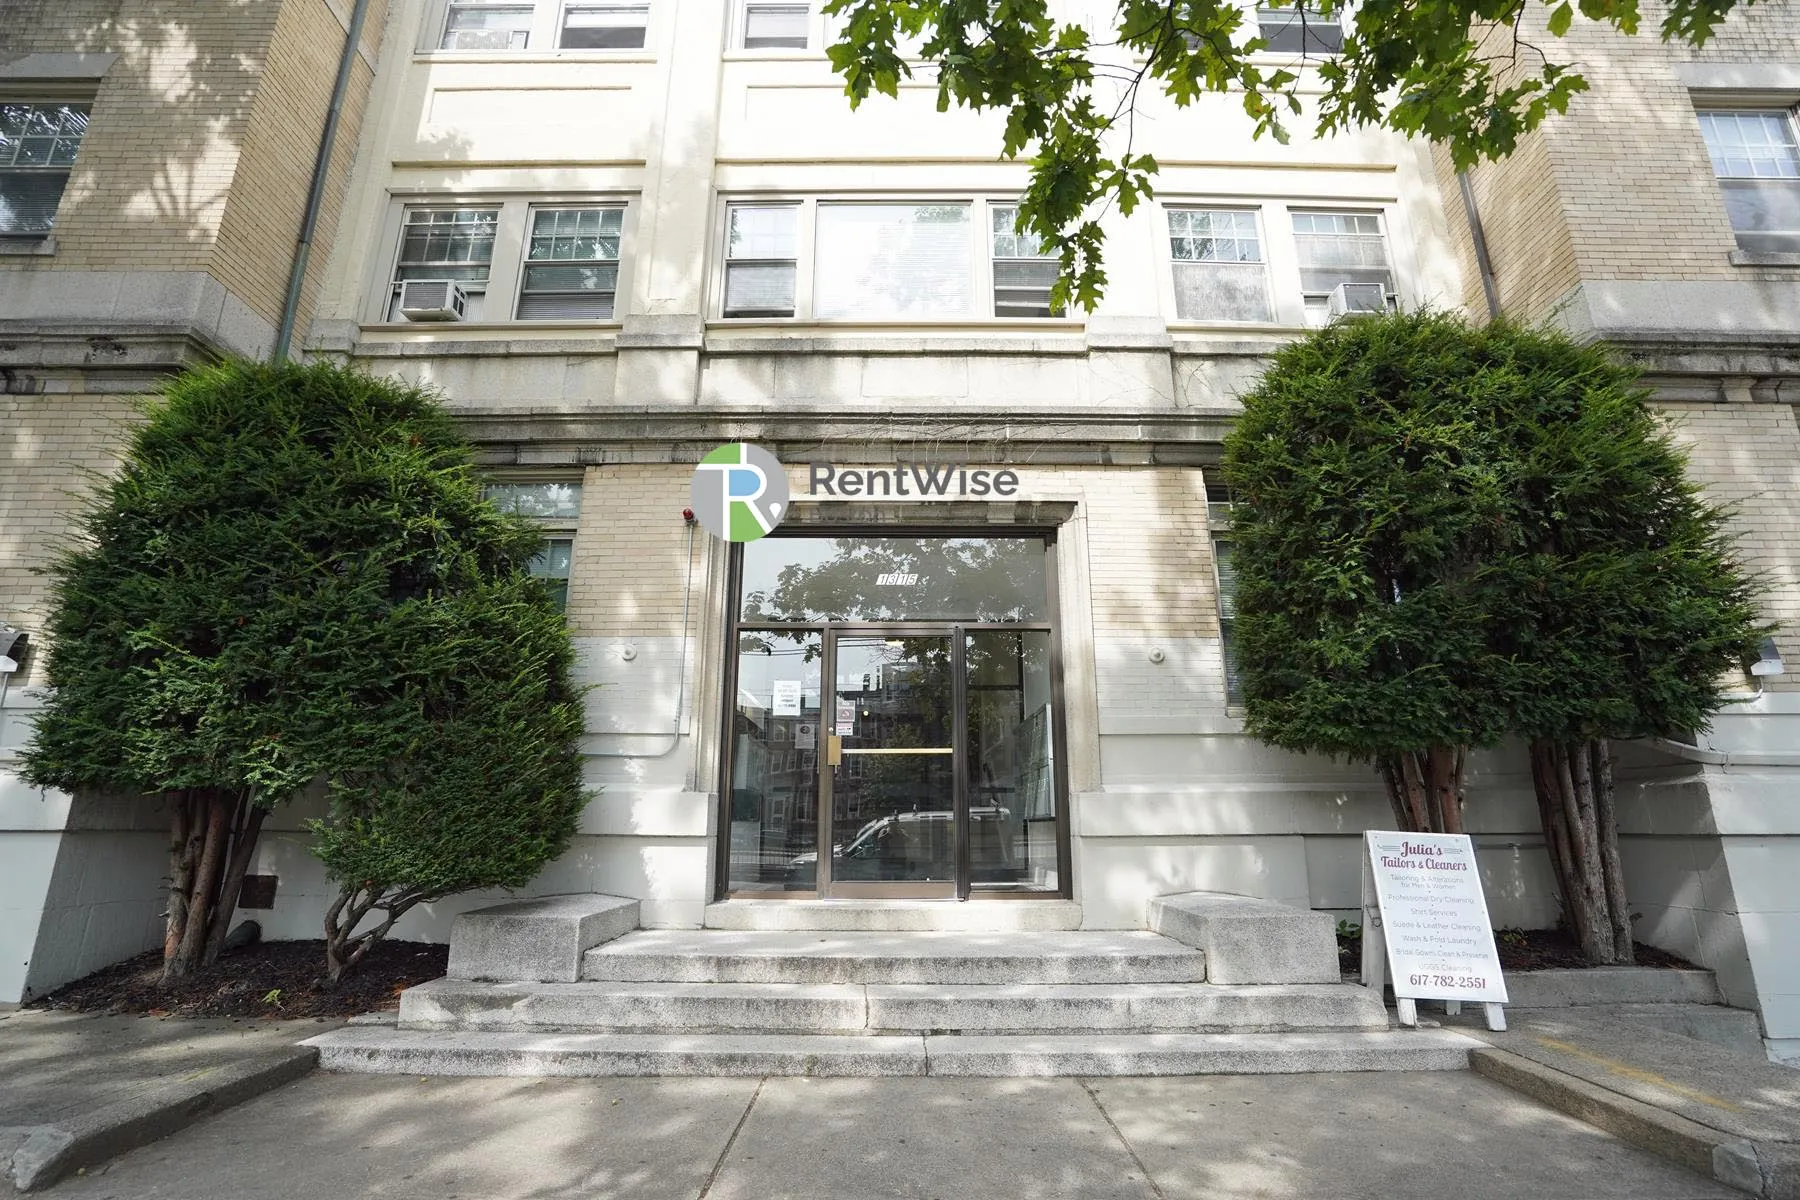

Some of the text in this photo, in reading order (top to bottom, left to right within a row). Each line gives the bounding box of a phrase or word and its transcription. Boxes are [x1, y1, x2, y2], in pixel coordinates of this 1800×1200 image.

[877, 574, 918, 585] 1315
[1401, 841, 1442, 857] Julia's
[1381, 856, 1467, 871] Tailors & Cleaners
[1388, 894, 1428, 902] Professional
[1445, 896, 1474, 904] Cleaning
[1423, 922, 1449, 930] Leather
[1451, 923, 1481, 931] Cleaning
[1448, 938, 1477, 946] Laundry
[1410, 974, 1486, 989] 617-782-2551
